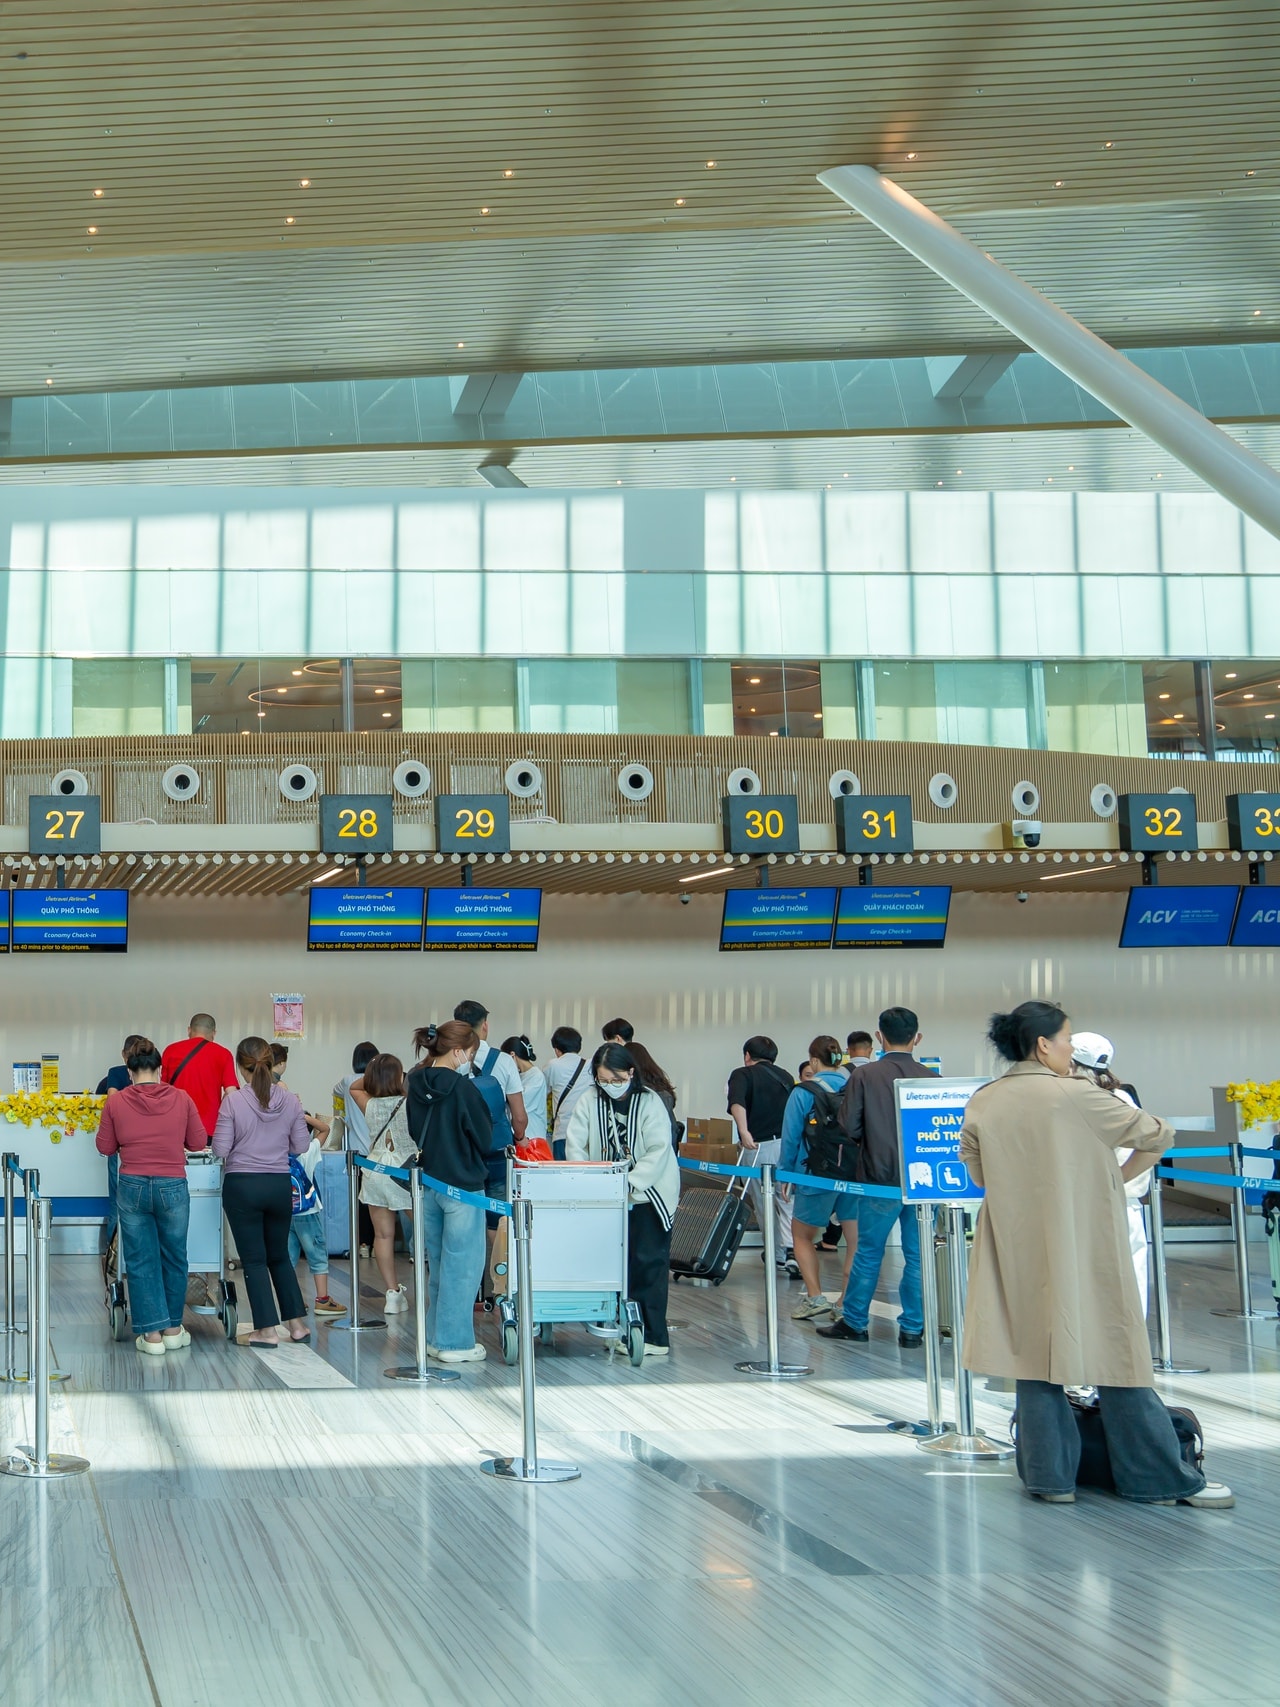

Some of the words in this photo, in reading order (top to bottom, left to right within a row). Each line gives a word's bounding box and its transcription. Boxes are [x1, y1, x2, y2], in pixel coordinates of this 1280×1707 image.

[45, 810, 85, 839] 27
[338, 809, 378, 838] 28
[455, 809, 495, 838] 29
[745, 809, 784, 839] 30
[862, 810, 896, 839] 31
[1144, 807, 1183, 836] 32
[76, 906, 100, 914] THÔNG
[372, 904, 396, 912] THÔNG
[489, 905, 513, 913] THÔNG
[786, 904, 808, 912] THÔNG
[1138, 910, 1177, 924] ACV
[906, 1092, 940, 1100] Vietravel
[941, 1092, 970, 1100] Airlines
[931, 1113, 963, 1127] QUẦY
[916, 1145, 951, 1154] Economy
[834, 1181, 847, 1192] ACV
[1242, 1178, 1261, 1188] ACV
